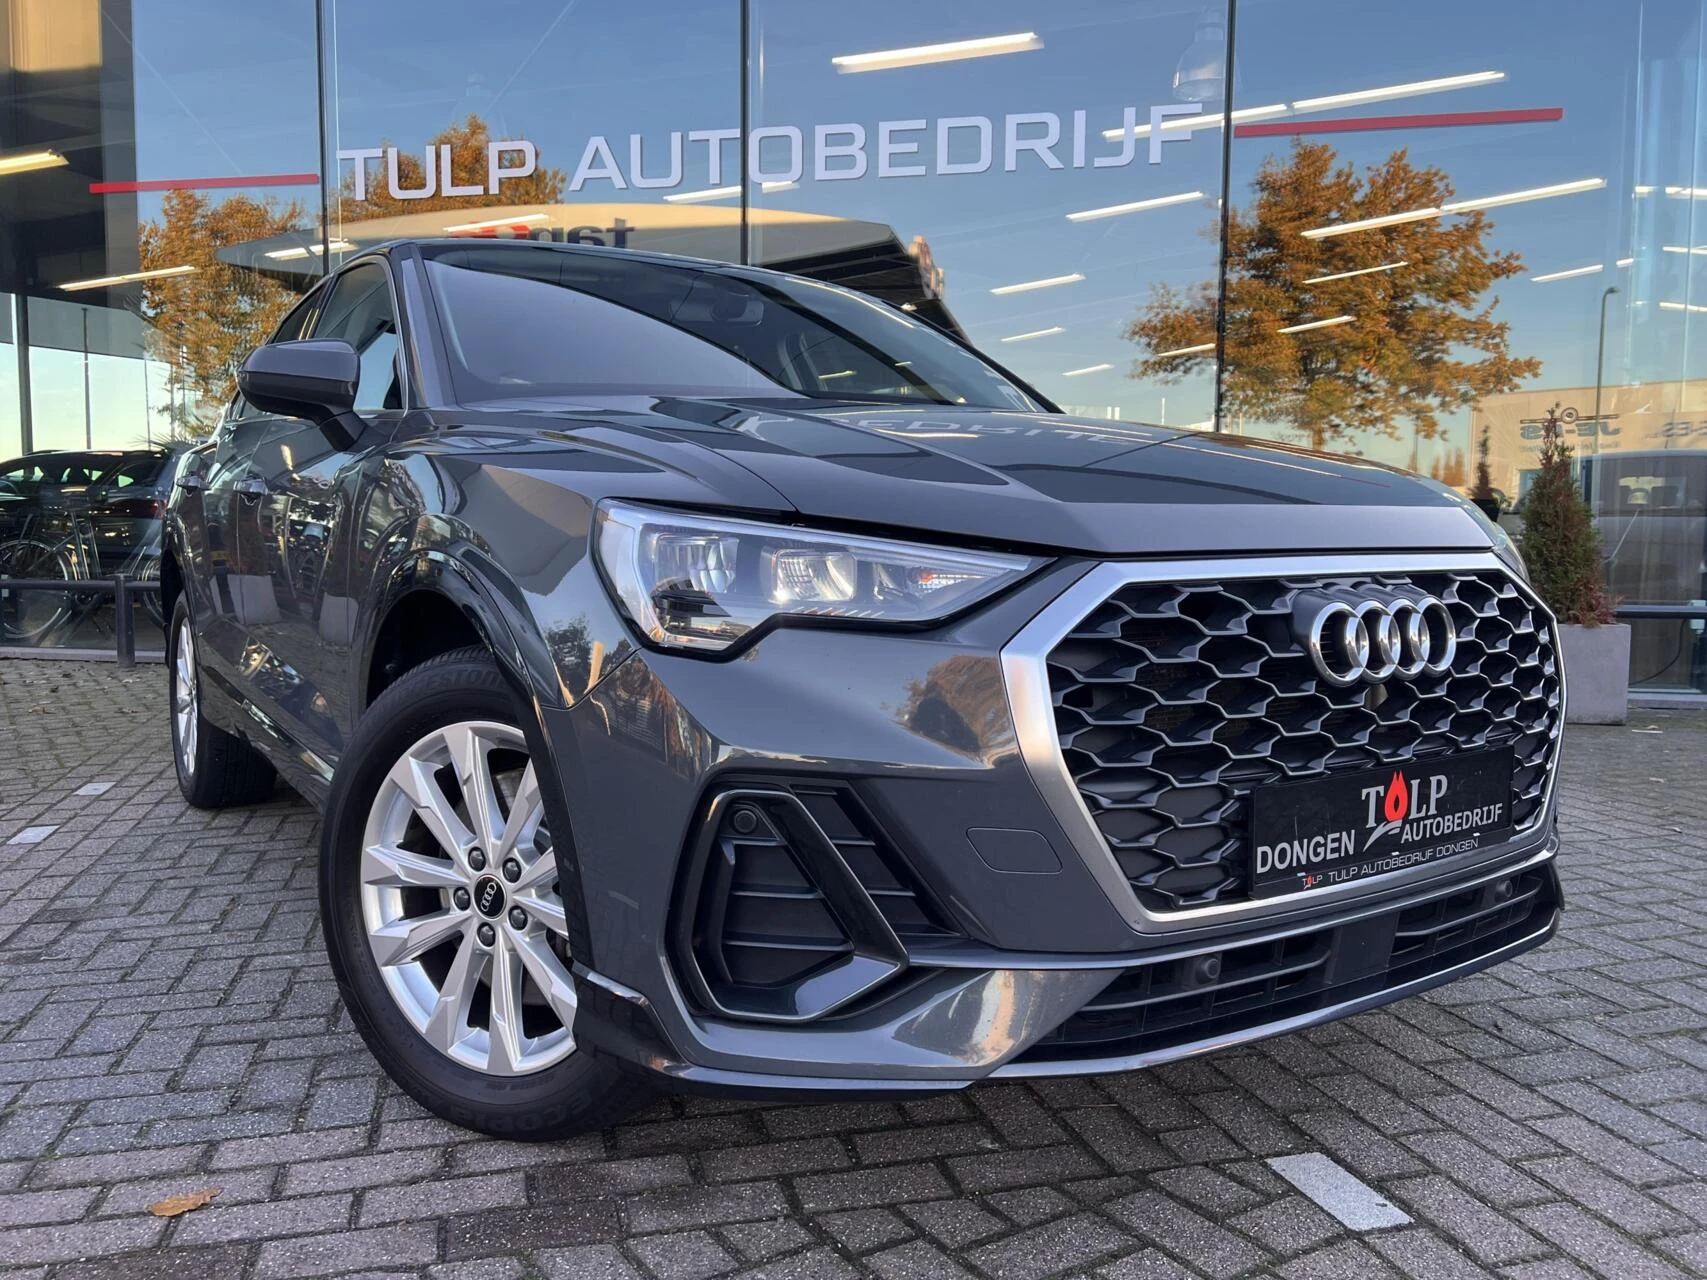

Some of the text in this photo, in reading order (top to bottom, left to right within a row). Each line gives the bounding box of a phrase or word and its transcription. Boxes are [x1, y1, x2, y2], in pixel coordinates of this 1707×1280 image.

[336, 103, 1203, 201] TULP AUTOBEDRIJF
[1400, 803, 1503, 844] AUTOBEDRIJF
[1256, 829, 1355, 874] DONGEN
[1328, 867, 1358, 883] TULP
[1360, 851, 1434, 876] AUTOBEDRIJF
[1436, 838, 1479, 857] DONGEN
